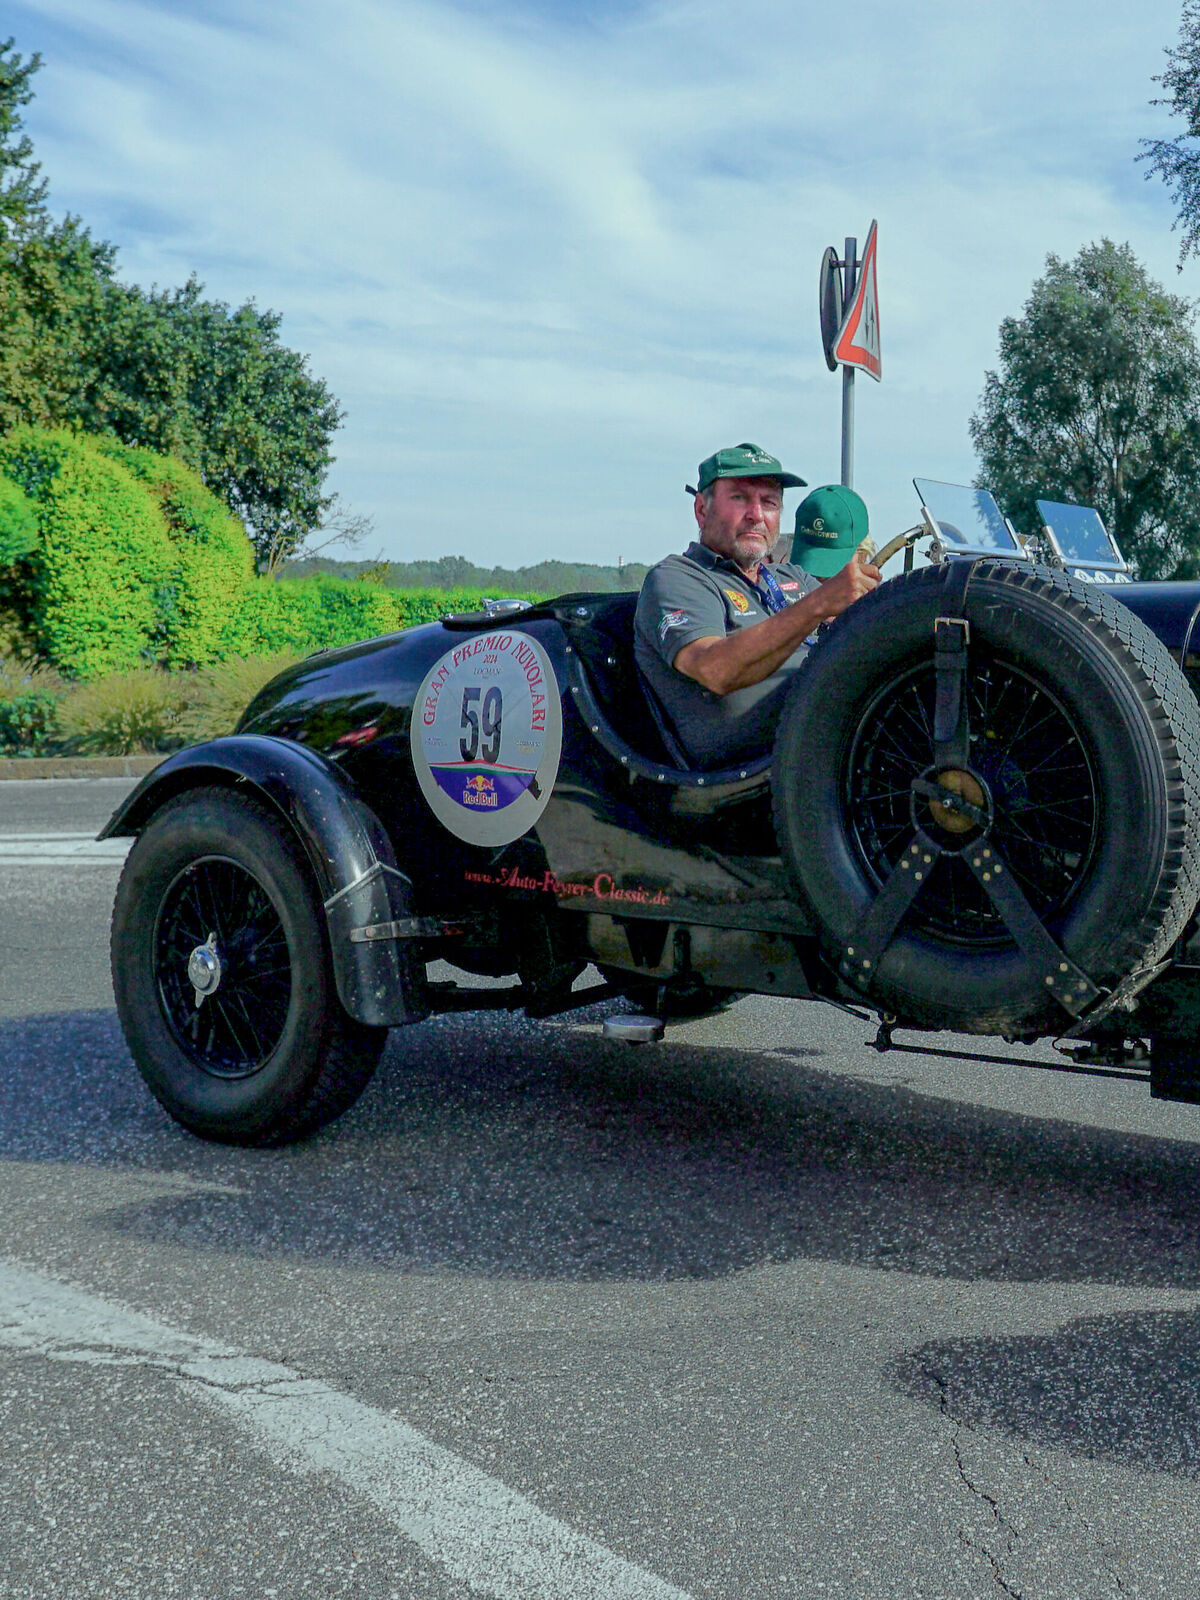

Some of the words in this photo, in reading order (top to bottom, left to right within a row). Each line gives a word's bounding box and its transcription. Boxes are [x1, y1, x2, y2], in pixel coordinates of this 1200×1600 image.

[423, 664, 450, 726] GRAN
[452, 635, 513, 668] PREMIO
[511, 640, 546, 732] NUVOLARI
[459, 686, 503, 763] 59
